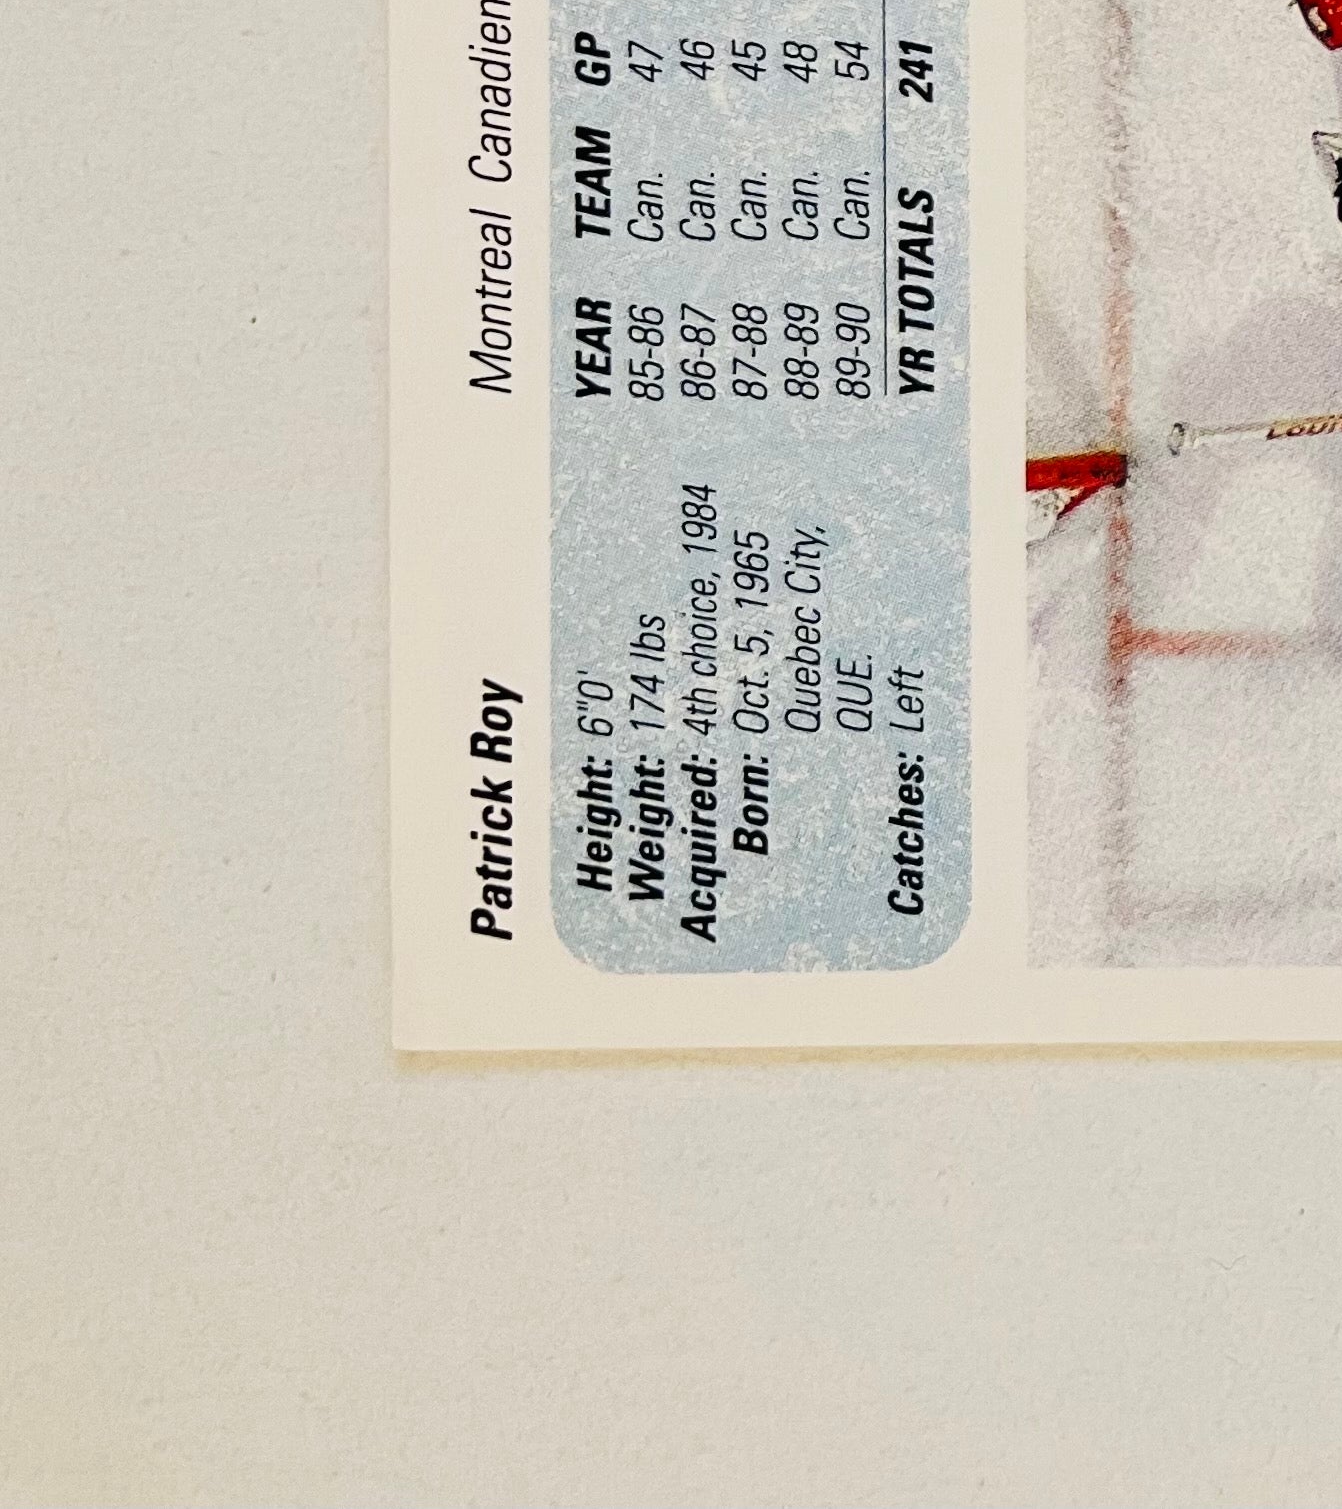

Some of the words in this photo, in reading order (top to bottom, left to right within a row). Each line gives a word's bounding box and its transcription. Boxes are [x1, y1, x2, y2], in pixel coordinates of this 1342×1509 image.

[575, 31, 610, 86] GP
[628, 41, 664, 82] 47
[732, 40, 766, 81] 45
[899, 41, 933, 102] 241
[575, 126, 612, 238] TEAM
[627, 174, 663, 242] Can.
[731, 173, 766, 240] Can.
[898, 188, 934, 332] TOTALS
[469, 209, 512, 393] Montreal
[575, 297, 612, 397] YEAR
[628, 305, 664, 401] 85-86
[732, 303, 767, 400] 87-88
[899, 347, 934, 394] YR
[681, 485, 717, 553] 1984
[733, 530, 769, 608] 1965
[784, 527, 829, 593] City,
[630, 615, 665, 661] lbs
[682, 573, 720, 676] choice,
[734, 630, 773, 656] 5,
[629, 675, 665, 729] 174
[732, 672, 769, 733] Oct.
[784, 607, 821, 732] Quebec
[836, 655, 872, 731] QUE.
[888, 666, 924, 732] Left
[470, 679, 523, 763] Roy
[682, 688, 717, 736] 4th
[576, 756, 621, 891] Height:
[629, 755, 674, 900] Weight:
[733, 754, 768, 855] Born:
[888, 752, 924, 915] Catches:
[471, 776, 512, 940] Patrick
[681, 755, 726, 943] Acquired:
